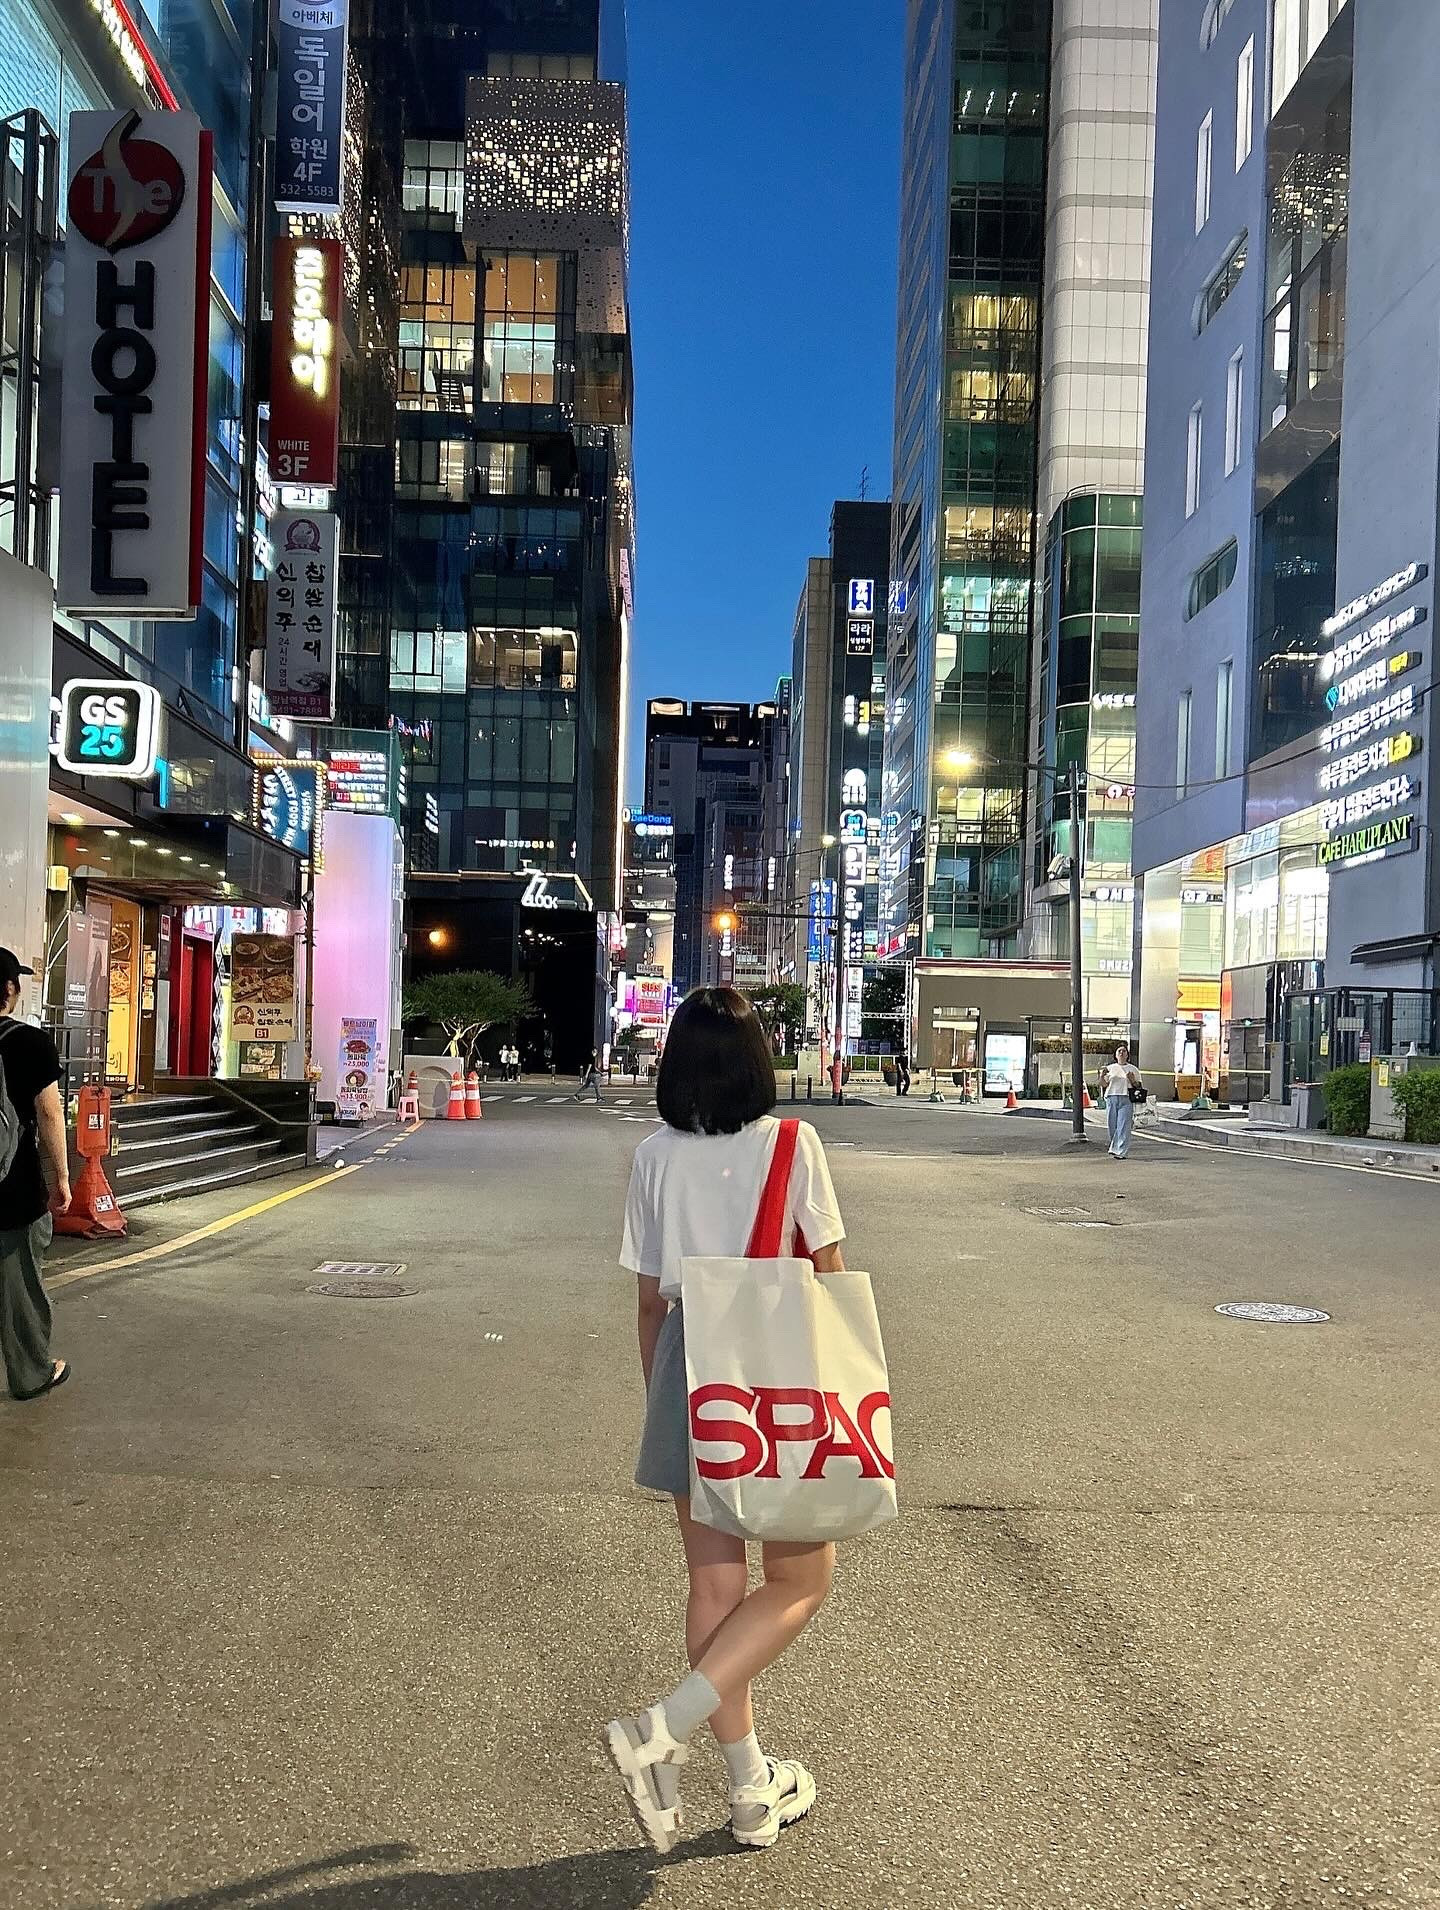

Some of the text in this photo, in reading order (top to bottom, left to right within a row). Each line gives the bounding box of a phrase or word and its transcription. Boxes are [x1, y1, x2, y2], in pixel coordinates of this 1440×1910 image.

[292, 10, 334, 25] 아베체
[292, 35, 329, 132] 독일어
[290, 136, 328, 160] 학원
[293, 162, 322, 182] 4F
[280, 183, 334, 197] 532-5583
[90, 260, 156, 595] HOTEL
[278, 440, 310, 451] WHITE
[277, 454, 310, 477] 3F
[275, 561, 297, 632] 신의주
[302, 561, 326, 662] 찹쌀순대
[850, 623, 871, 636] 라라
[80, 694, 127, 725] GS
[80, 725, 124, 757] 25
[288, 799, 299, 827] FOOD
[631, 815, 671, 824] DaeDong
[1341, 814, 1413, 858] HARUPLANT
[256, 1029, 268, 1038] B1
